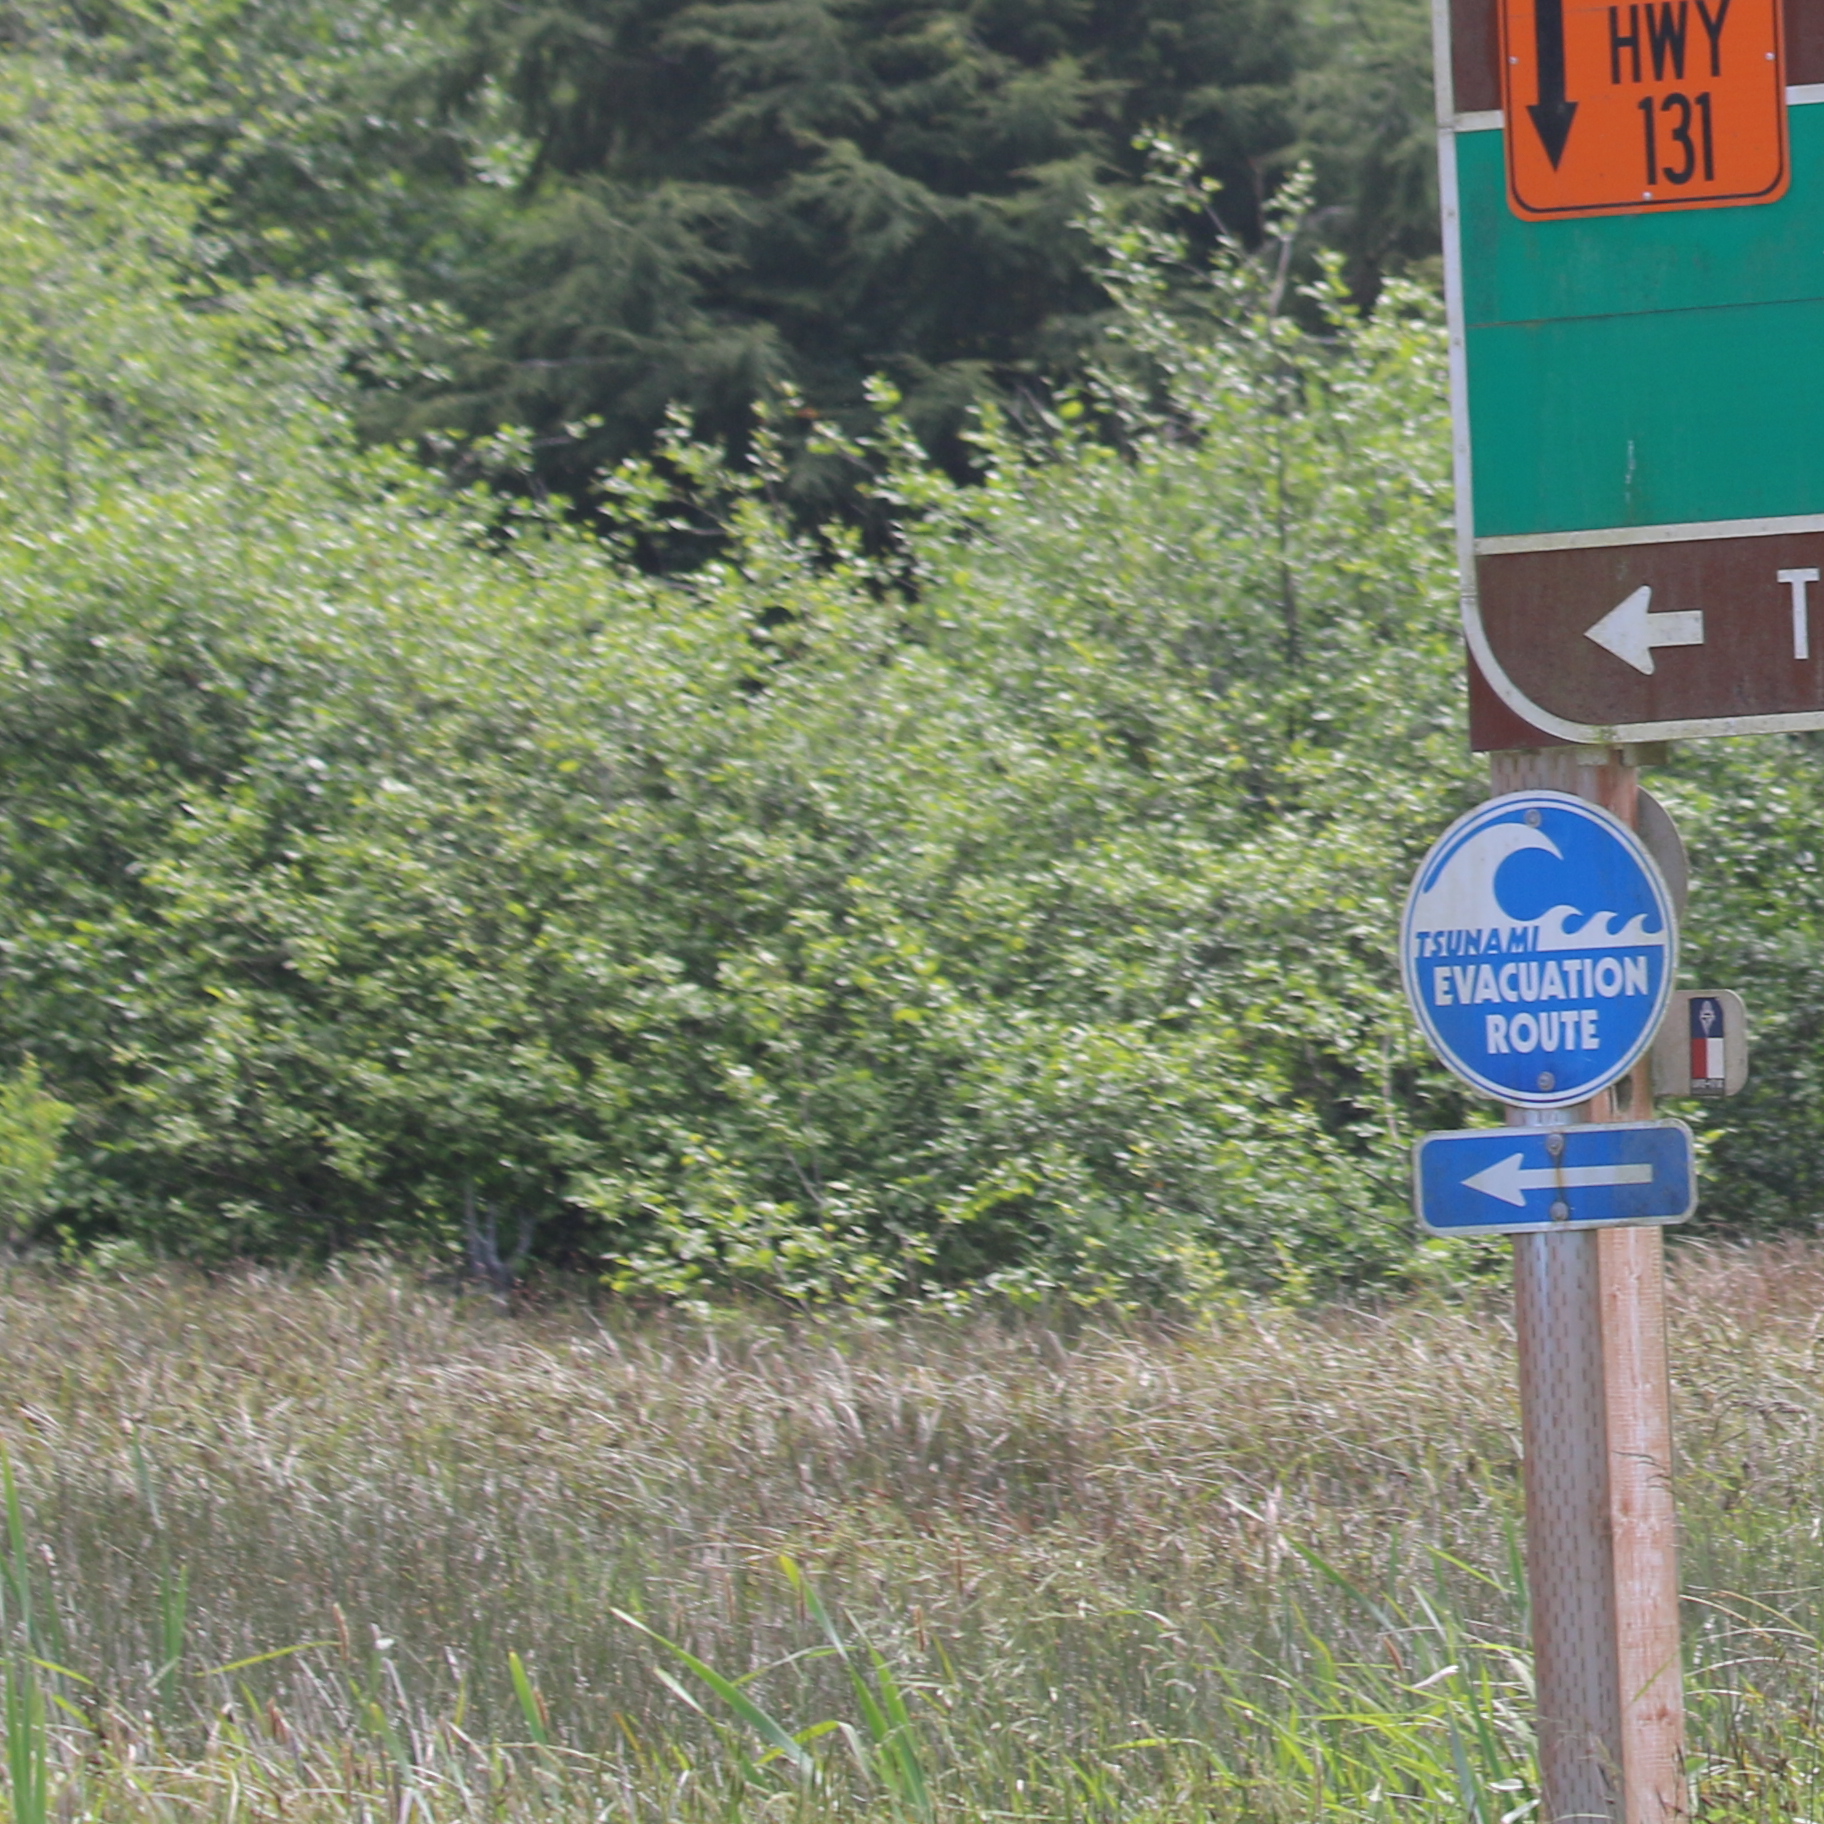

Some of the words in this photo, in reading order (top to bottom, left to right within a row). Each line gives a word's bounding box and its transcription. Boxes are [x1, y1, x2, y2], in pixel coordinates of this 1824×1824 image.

[1637, 91, 1716, 186] 131
[1415, 925, 1540, 959] TSUNAMI
[1433, 955, 1649, 1007] EVACUATION
[1486, 1008, 1600, 1055] ROUTE
